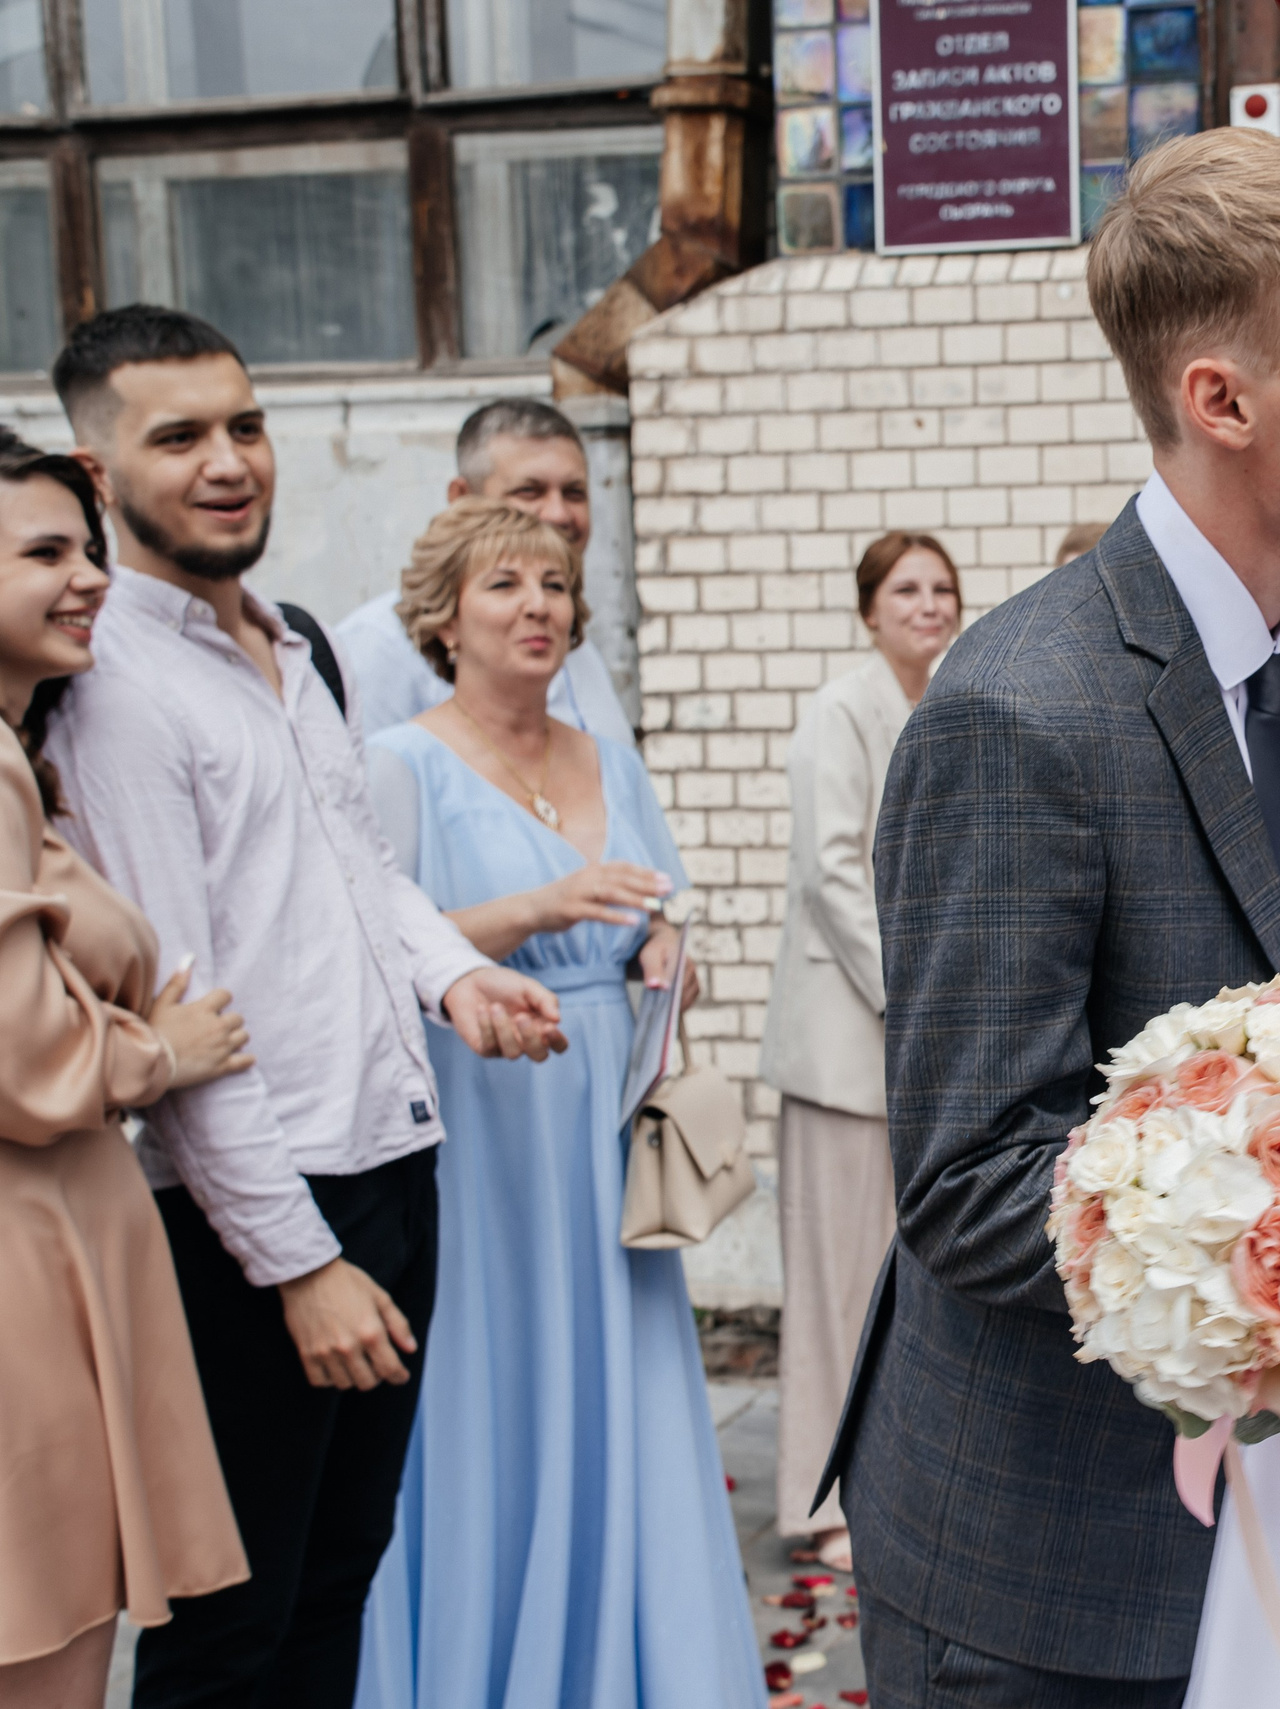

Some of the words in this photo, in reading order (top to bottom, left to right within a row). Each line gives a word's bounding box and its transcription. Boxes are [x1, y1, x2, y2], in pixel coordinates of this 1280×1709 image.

[935, 32, 1010, 56] ОТДЕЛ
[892, 67, 979, 91] ЗАПИСИ
[982, 61, 1056, 84] АКТОВ
[889, 93, 1062, 122] ГРАЖДАНСКОГО
[909, 127, 1041, 153] СОСТОЯНИЯ
